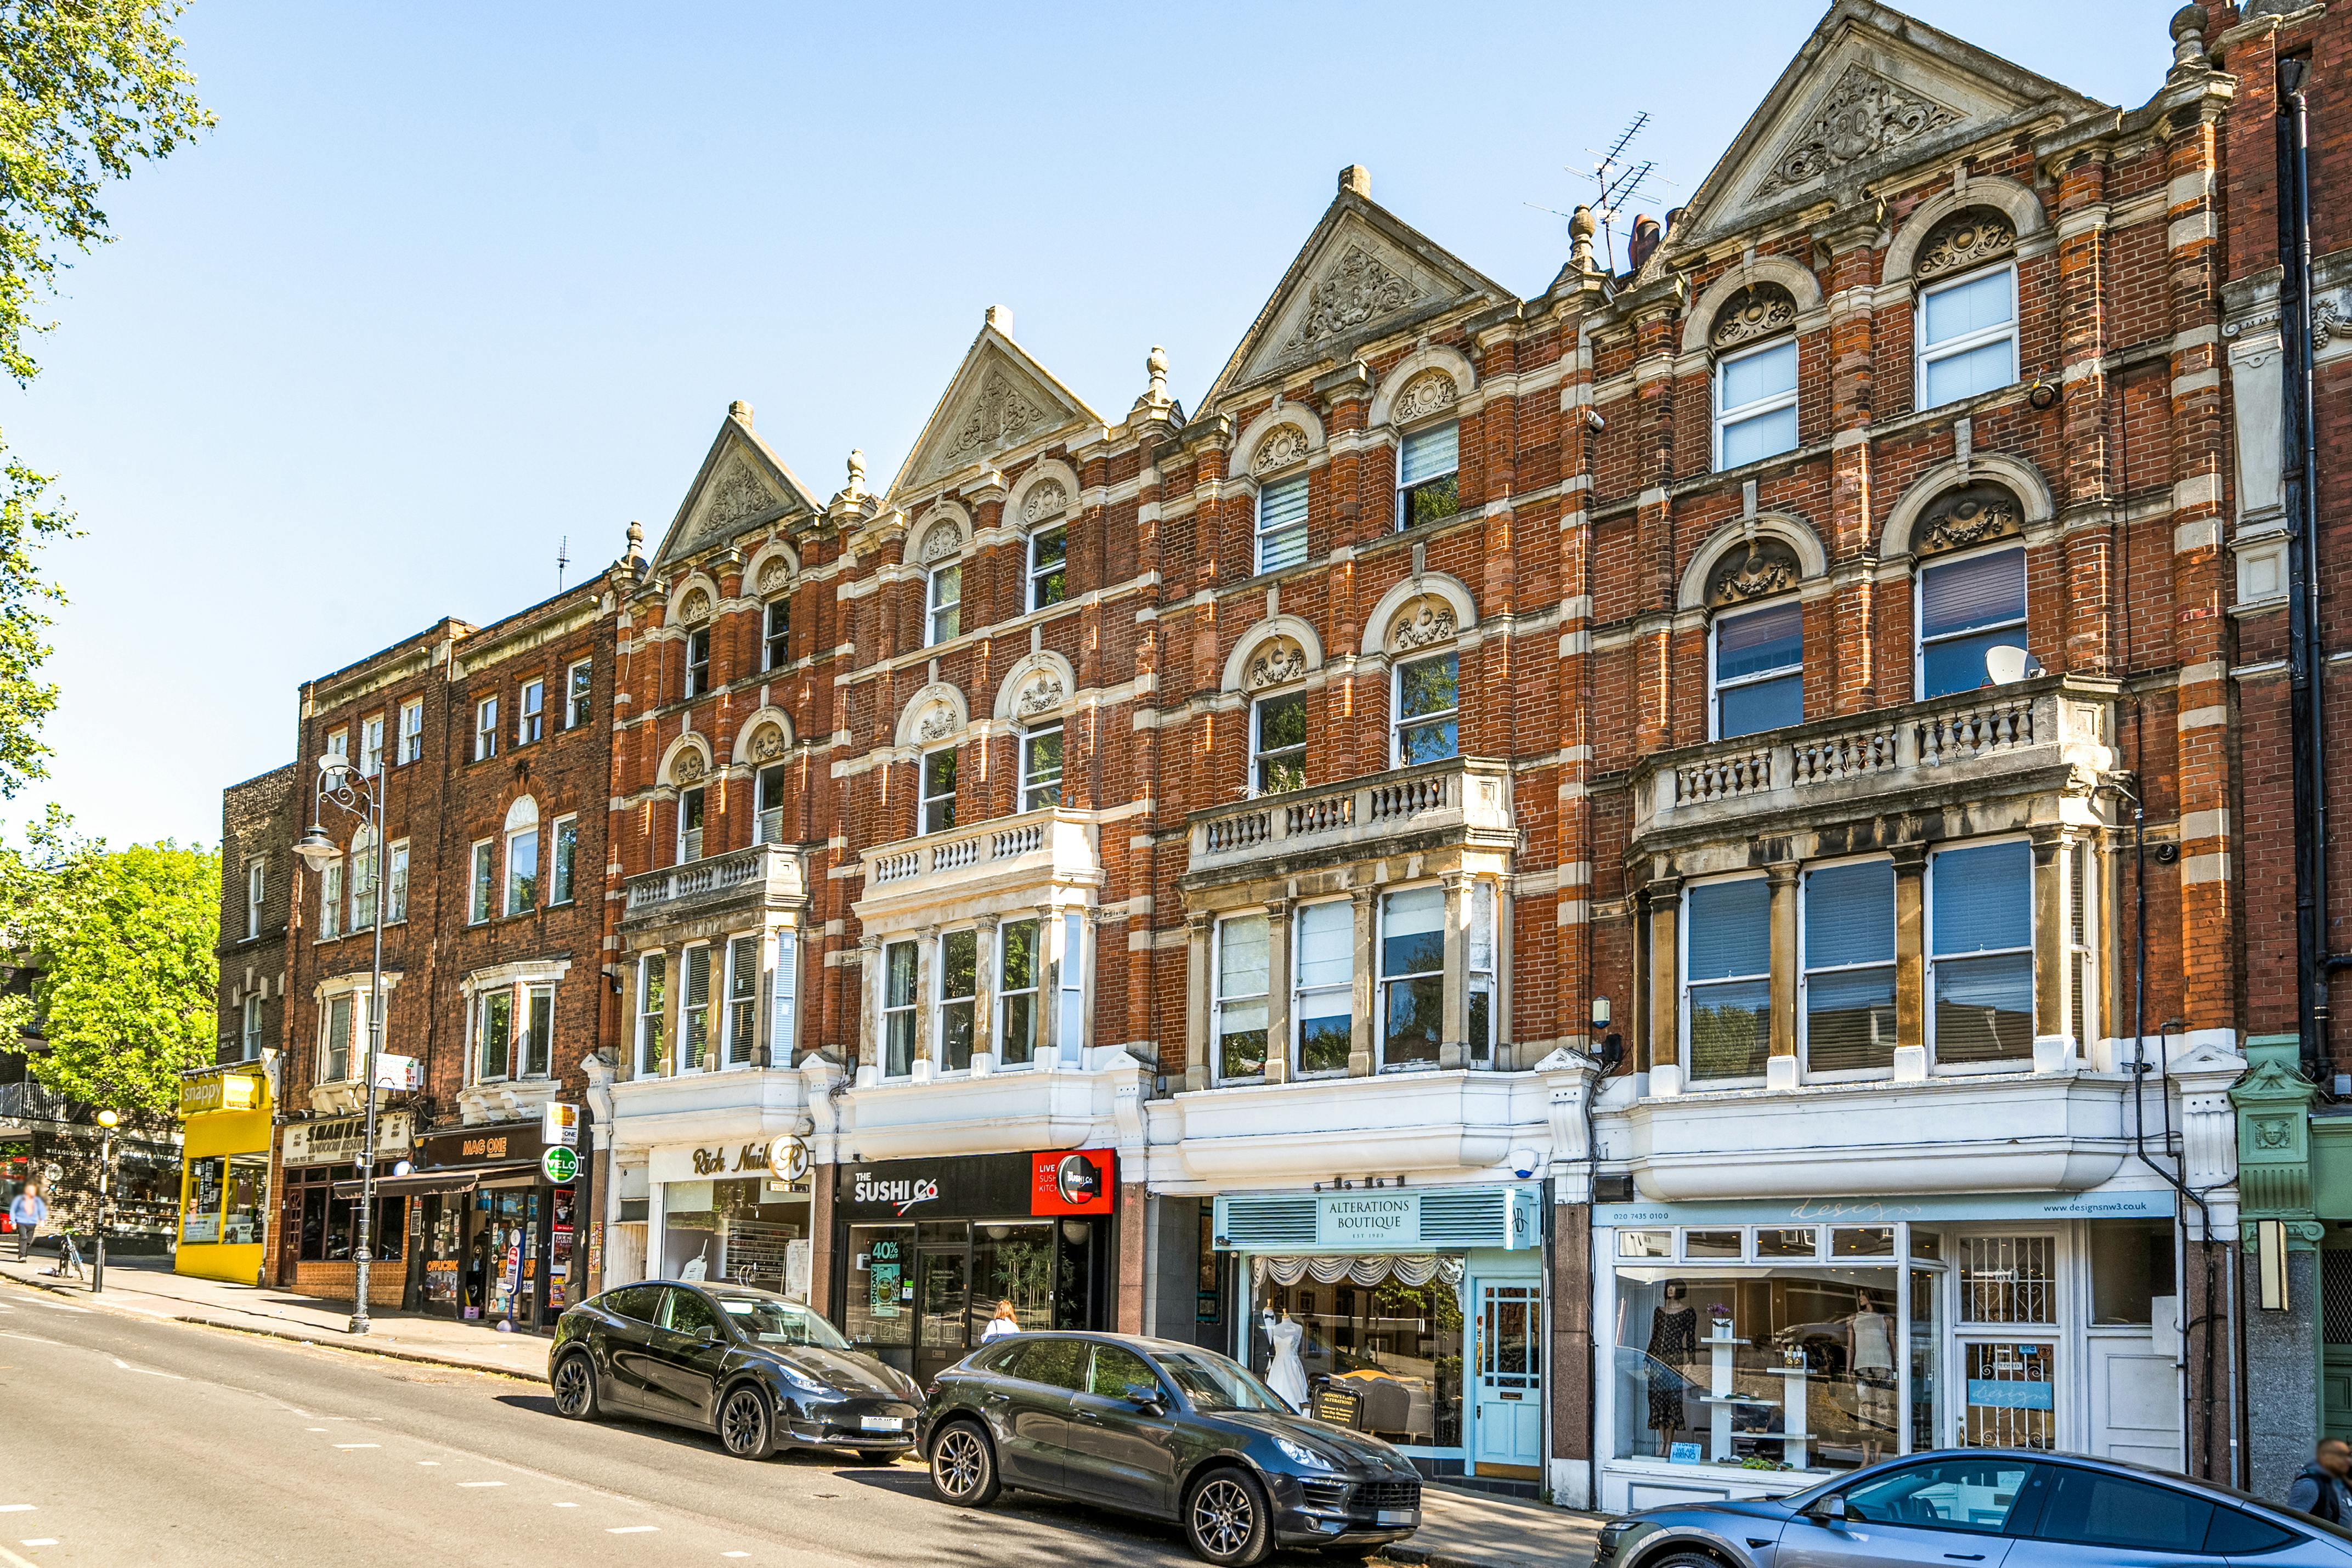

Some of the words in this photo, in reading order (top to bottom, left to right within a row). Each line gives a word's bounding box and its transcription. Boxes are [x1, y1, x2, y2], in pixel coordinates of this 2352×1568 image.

[184, 1083, 222, 1105] snappy
[342, 1137, 382, 1150] RESTAUNT
[463, 1140, 485, 1156] MAG
[487, 1137, 507, 1153] ONE
[547, 1159, 576, 1170] VELO
[693, 1147, 726, 1175] Rich
[1039, 1164, 1055, 1173] LIVE
[855, 1172, 872, 1181] THE
[855, 1180, 910, 1202] SUSHI
[1330, 1201, 1409, 1213] ALTERATIONS
[1338, 1216, 1400, 1230] BOUTIQUE
[872, 1242, 898, 1259] 40%
[1324, 1397, 1353, 1405] ALTERATIONS
